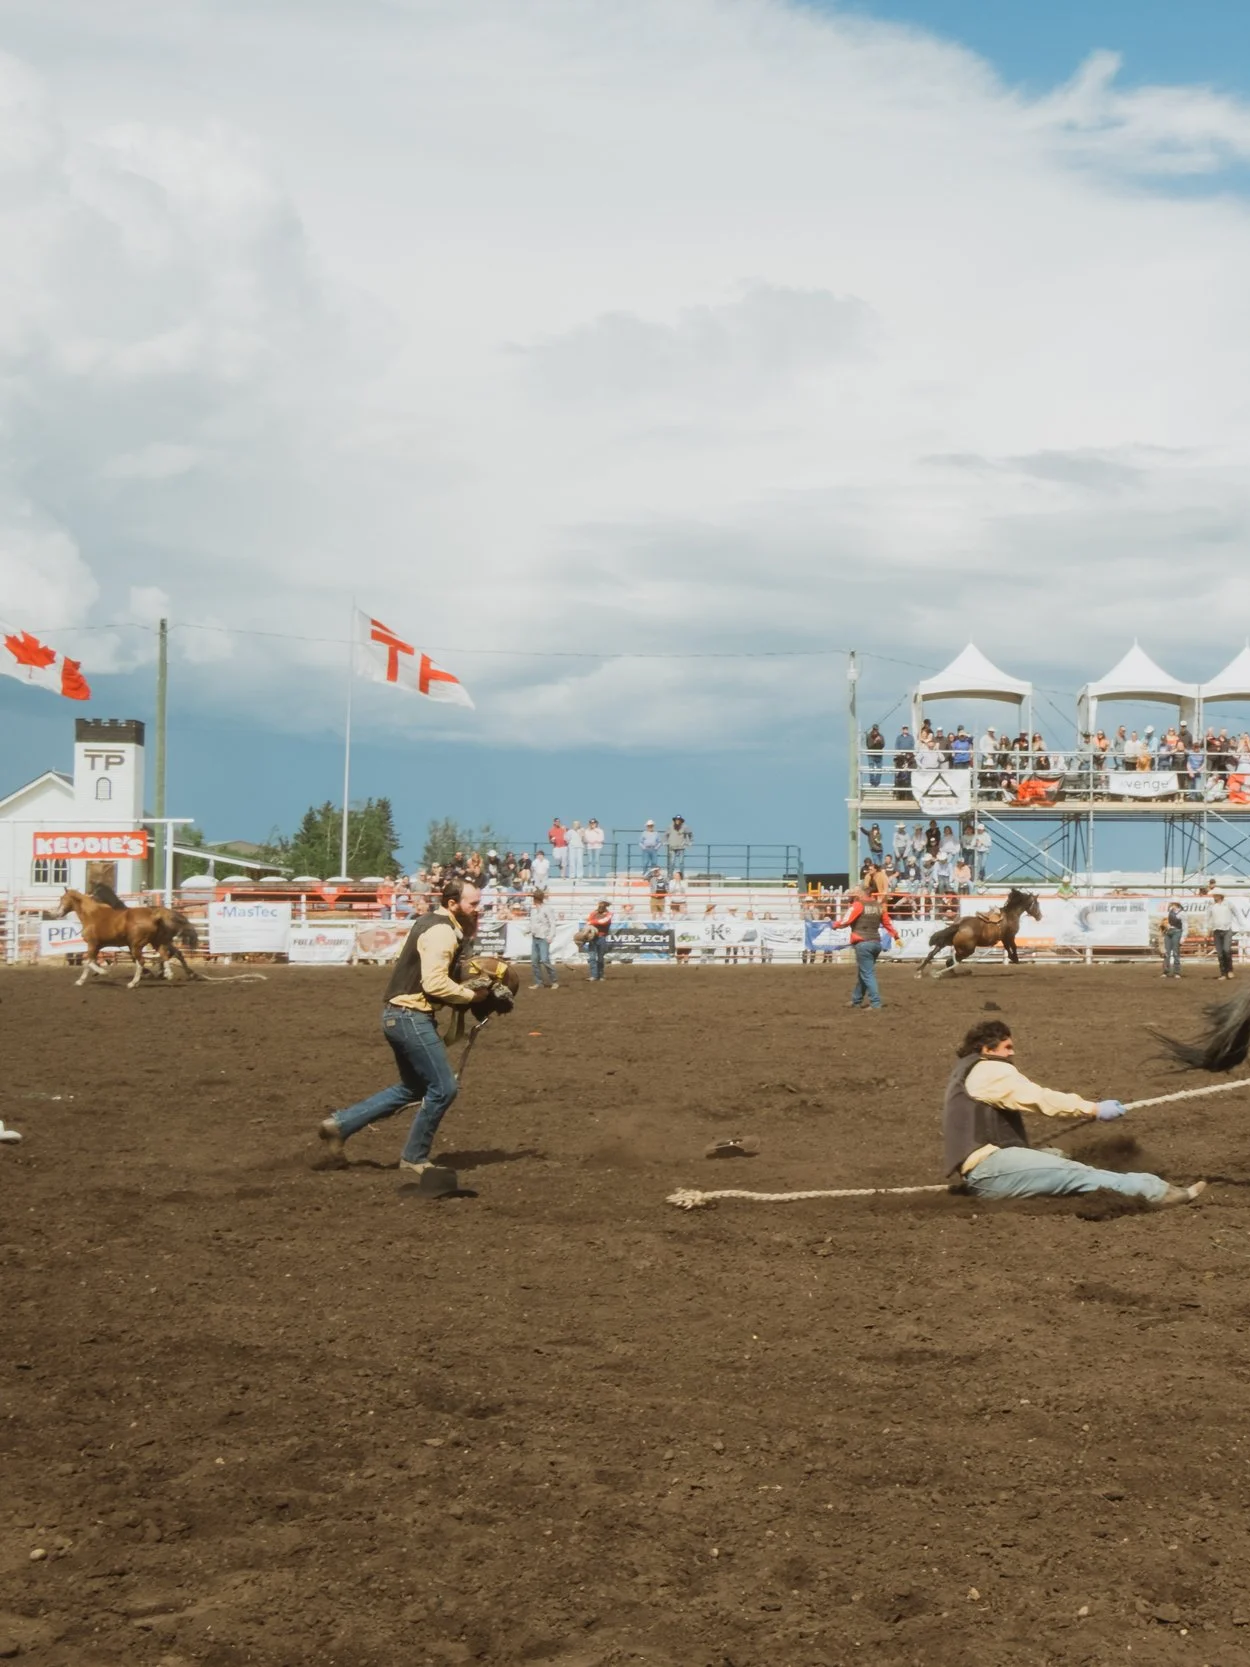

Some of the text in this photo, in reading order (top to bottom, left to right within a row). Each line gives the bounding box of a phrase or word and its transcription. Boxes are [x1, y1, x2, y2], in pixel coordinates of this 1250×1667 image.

[84, 753, 125, 771] TP
[35, 834, 144, 856] KEDDIE'S
[222, 905, 278, 918] MasTec
